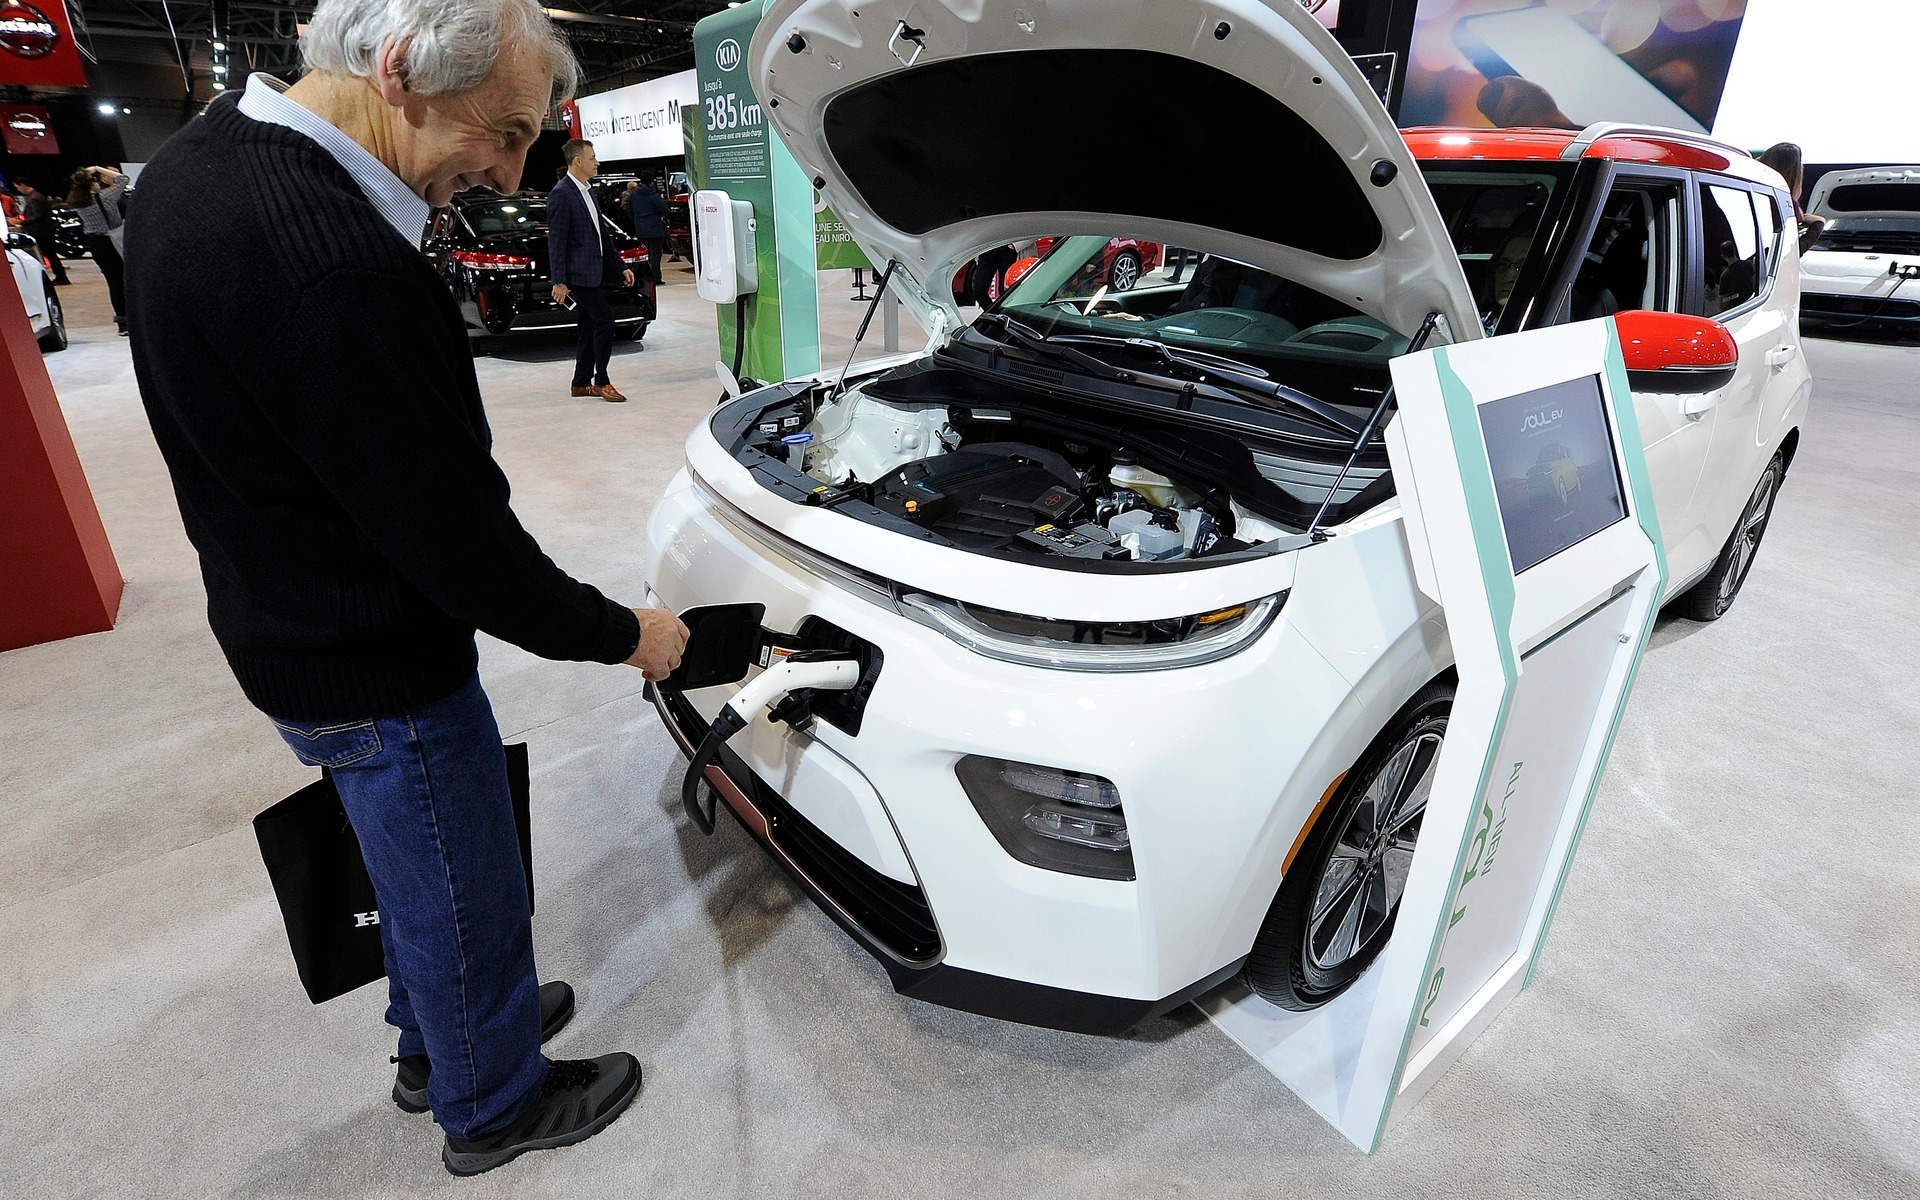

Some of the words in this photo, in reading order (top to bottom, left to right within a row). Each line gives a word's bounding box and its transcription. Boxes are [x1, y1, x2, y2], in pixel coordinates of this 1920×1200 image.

[719, 46, 737, 65] KIA
[705, 93, 738, 130] 385
[740, 99, 762, 126] km
[583, 119, 610, 138] NISSAN
[832, 233, 850, 243] NIRO
[1521, 412, 1551, 432] SOUL
[1552, 409, 1563, 420] EV
[1481, 761, 1523, 876] ALL-NEW
